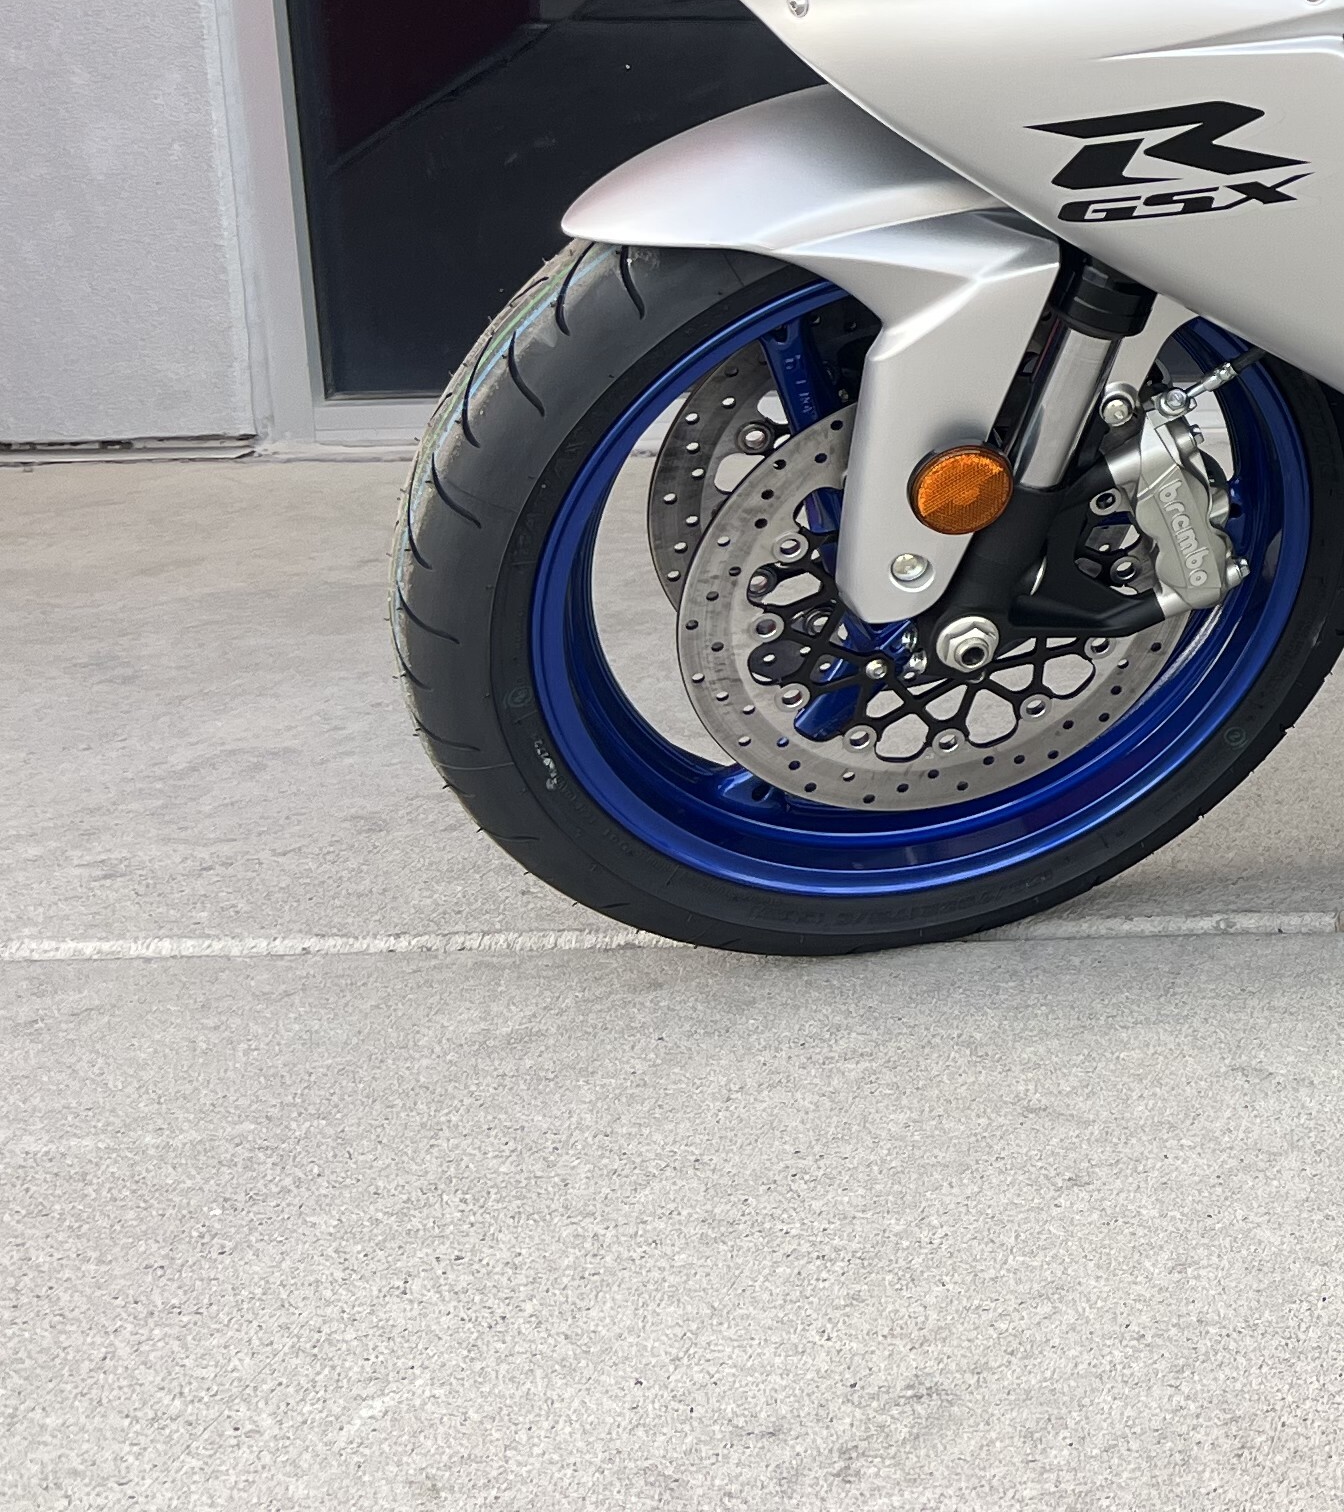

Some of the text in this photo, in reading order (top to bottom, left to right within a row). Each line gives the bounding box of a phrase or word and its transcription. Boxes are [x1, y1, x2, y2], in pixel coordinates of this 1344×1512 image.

[1022, 100, 1312, 191] R
[1056, 171, 1316, 223] GSX
[1158, 478, 1210, 587] brembo
